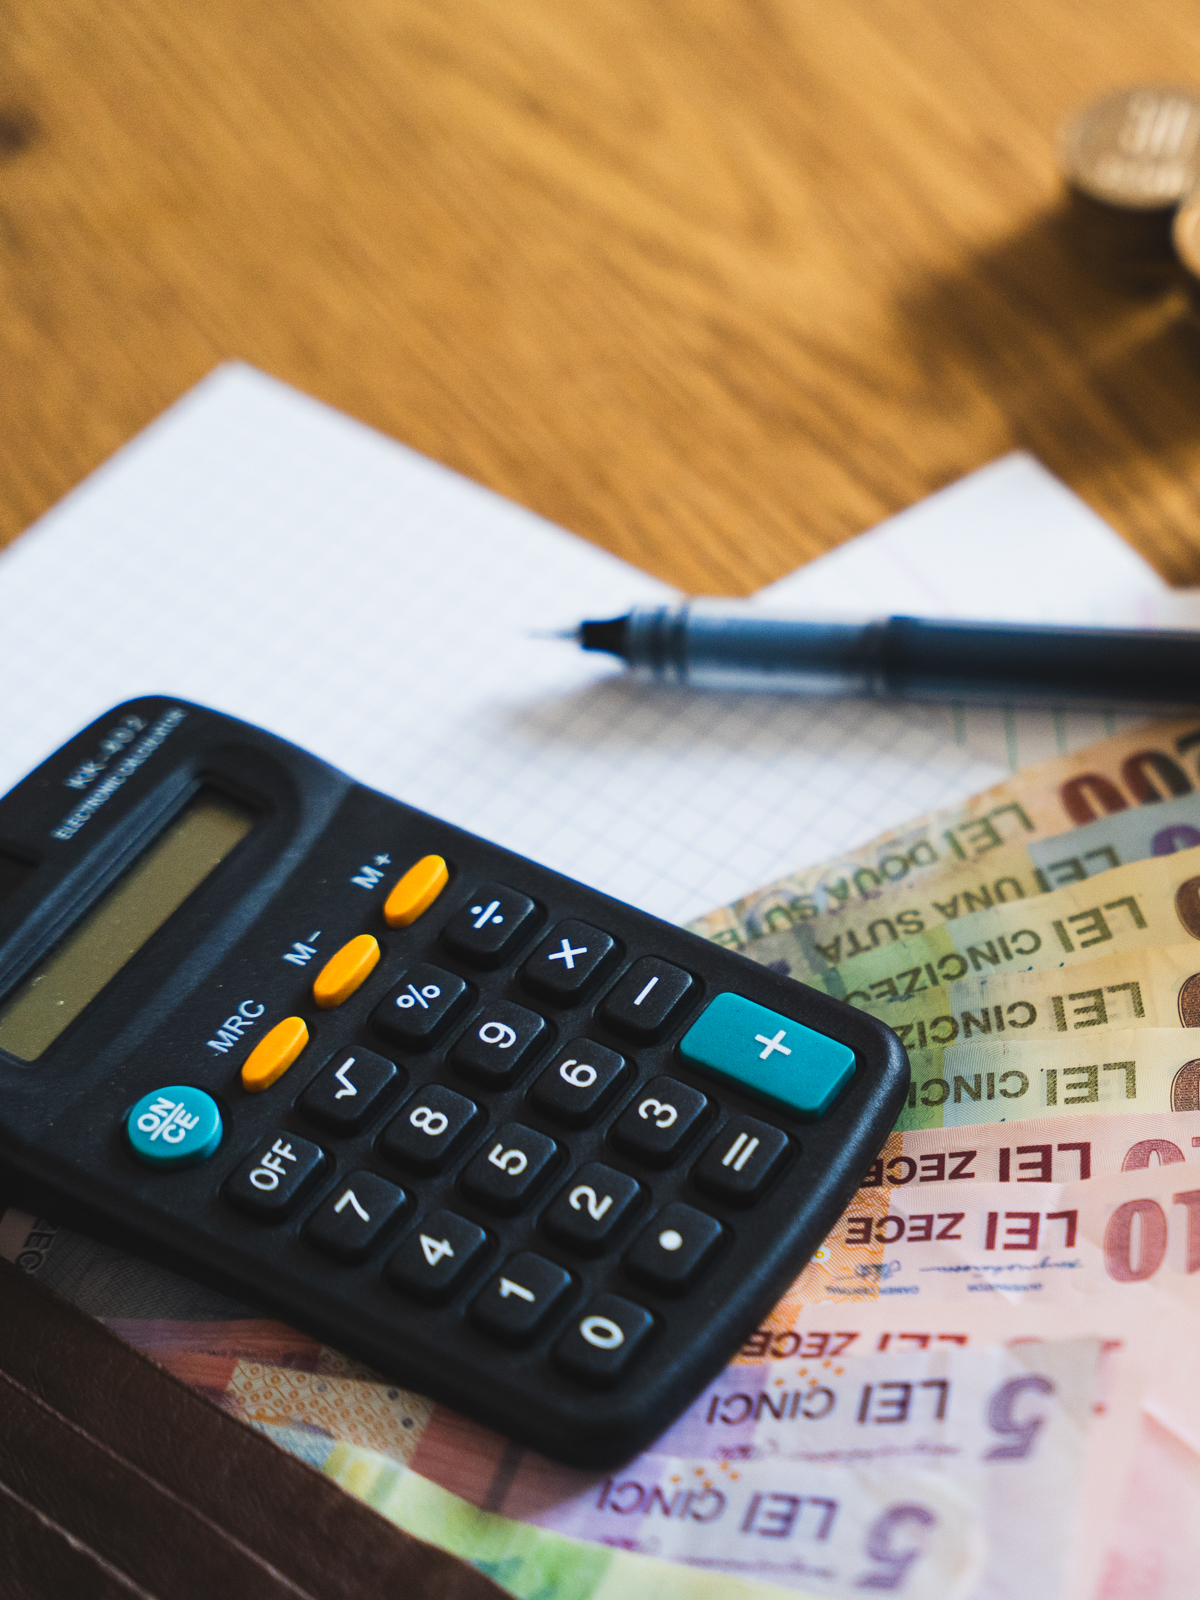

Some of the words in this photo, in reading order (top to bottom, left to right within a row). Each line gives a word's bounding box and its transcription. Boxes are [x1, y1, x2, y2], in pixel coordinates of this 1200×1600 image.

[946, 802, 1036, 861] LEI
[351, 853, 391, 890] M+
[931, 876, 1026, 920] UNA
[814, 909, 925, 964] SUTA
[1052, 895, 1148, 953] LEI
[283, 930, 322, 967] M-
[846, 929, 1043, 1004] CINCIZEC
[206, 999, 265, 1054] MRC
[891, 1000, 1038, 1051] CINCIZ
[1051, 981, 1147, 1032] LEI
[477, 1020, 518, 1050] 9
[559, 1058, 598, 1088] 6
[906, 1069, 1030, 1110] CINCI
[1046, 1060, 1137, 1107] LEI
[408, 1105, 450, 1136] 8
[637, 1097, 679, 1129] 3
[249, 1138, 298, 1191] OFF
[487, 1142, 529, 1176] 5
[998, 1141, 1092, 1184] LEI
[334, 1189, 371, 1222] 7
[568, 1185, 614, 1221] 2
[419, 1234, 454, 1266] 4
[844, 1211, 966, 1246] ZECE
[983, 1209, 1079, 1252] LEI
[500, 1277, 535, 1302] 1
[580, 1316, 625, 1349] 0
[705, 1384, 838, 1427] CINCI
[856, 1378, 951, 1427] LEI
[980, 1373, 1057, 1464] 5
[595, 1477, 727, 1525] CINCI
[741, 1490, 841, 1542] LEI
[853, 1500, 938, 1592] 5
